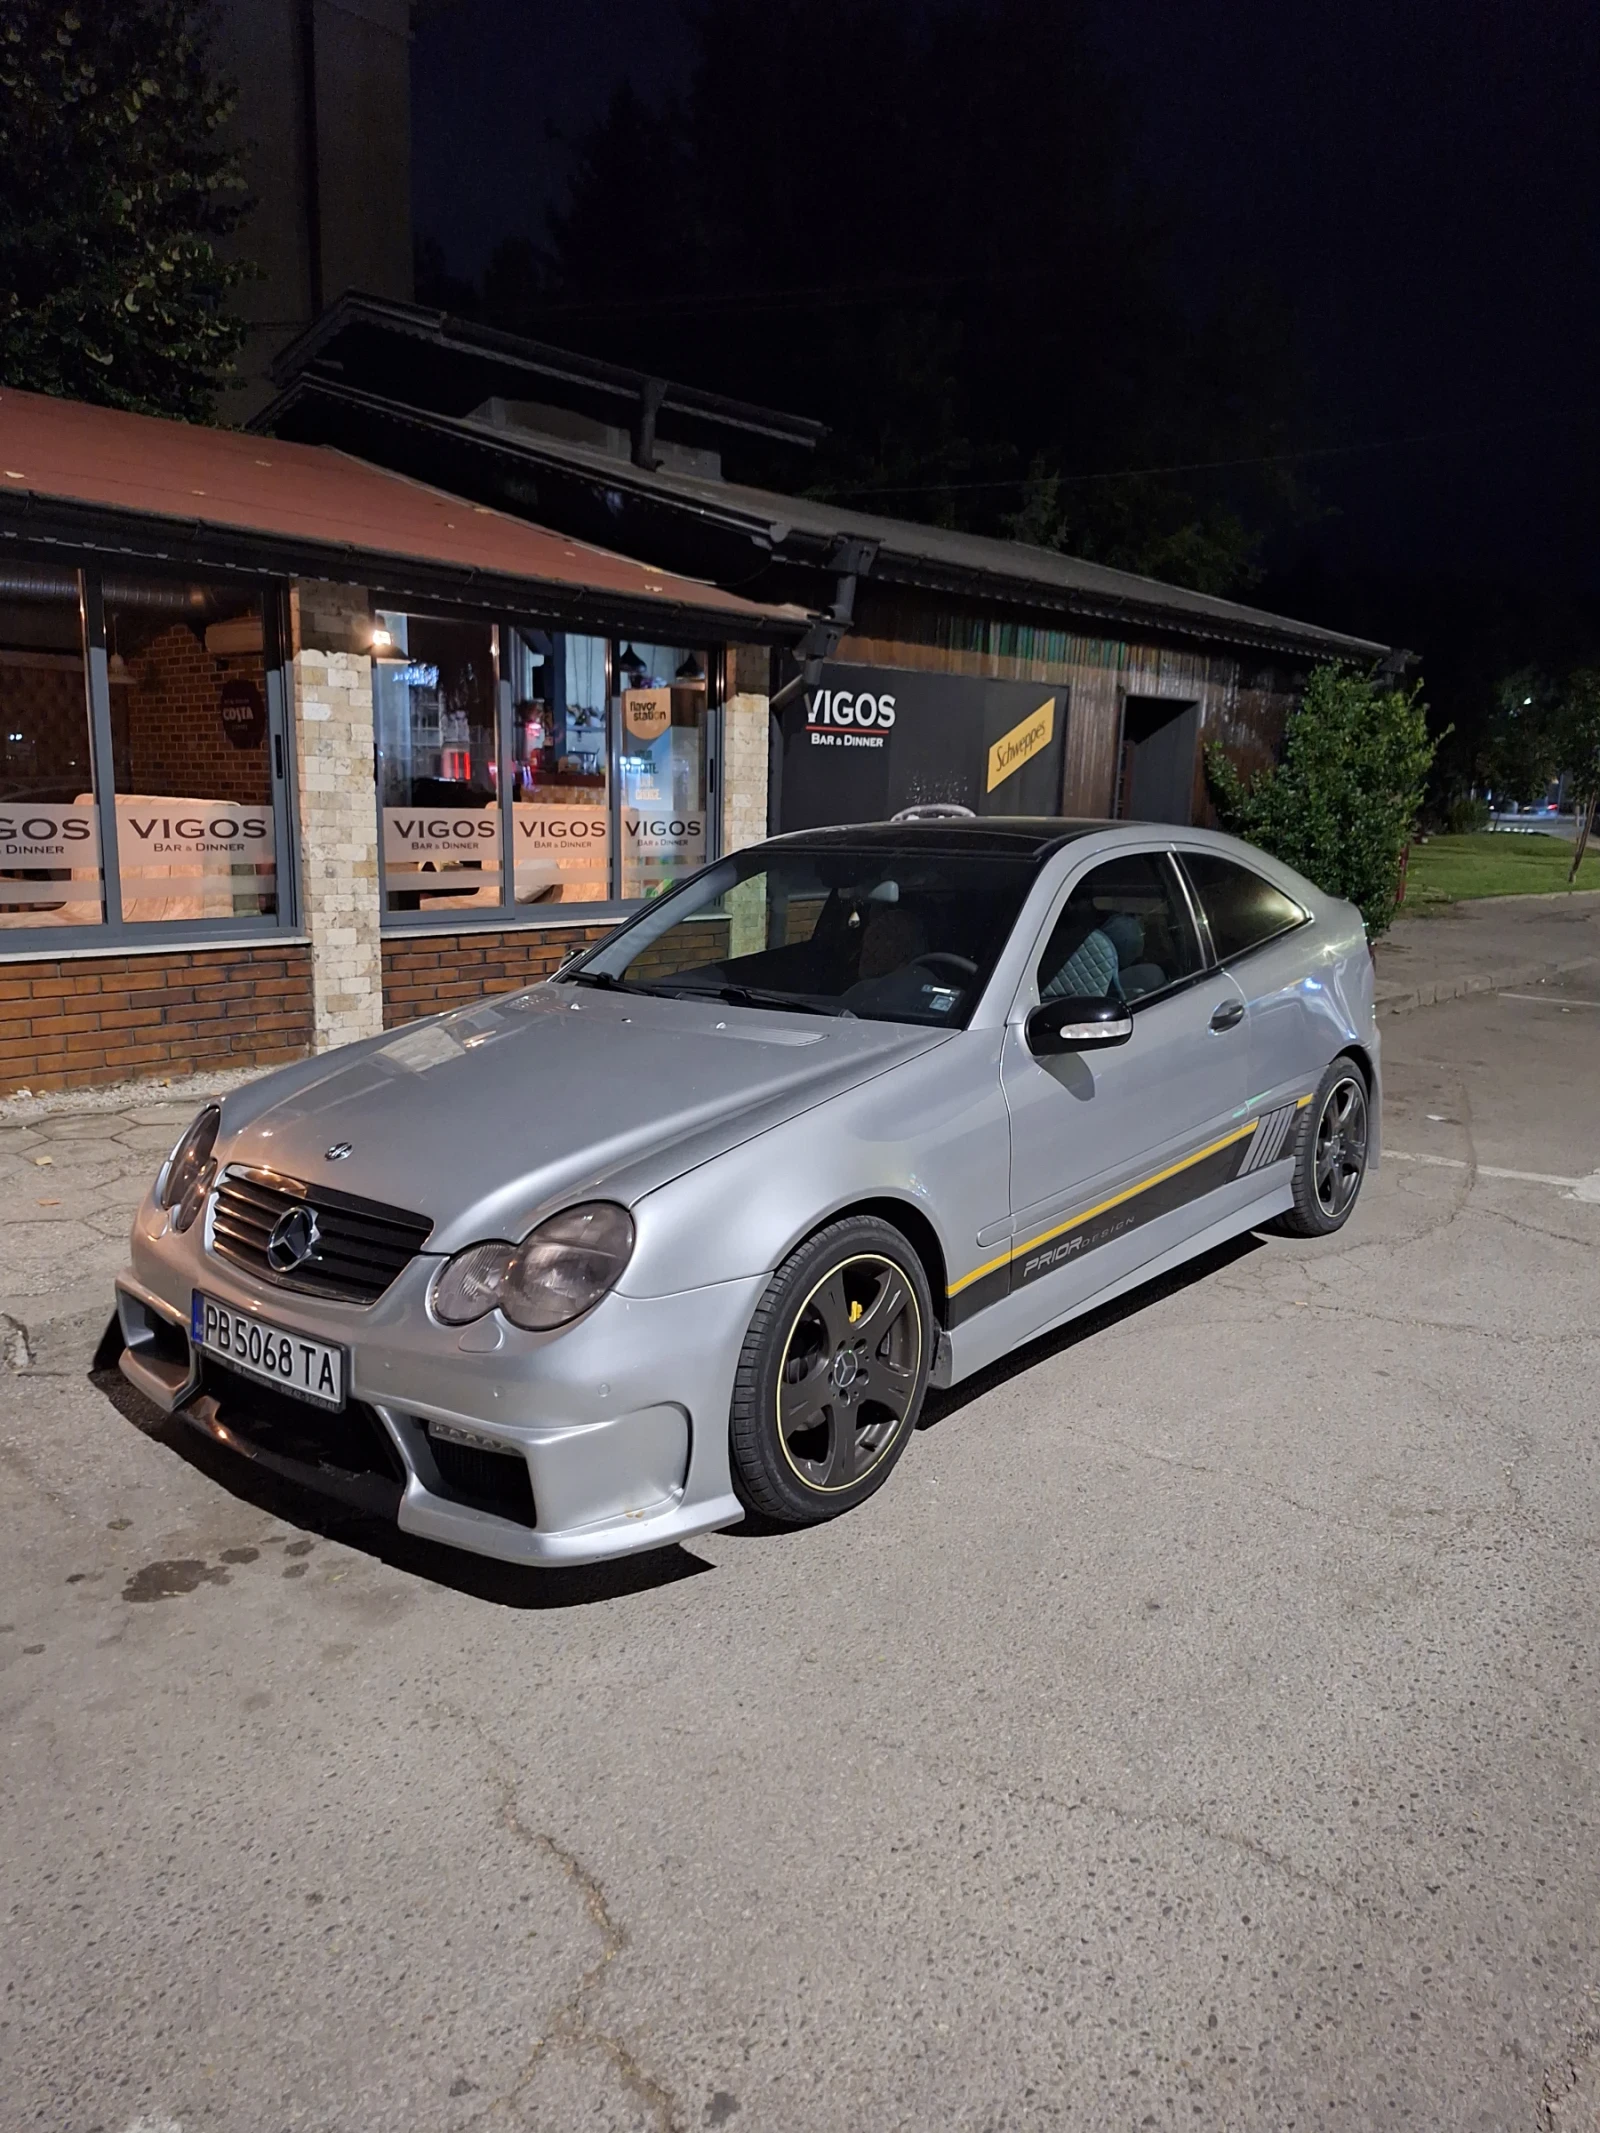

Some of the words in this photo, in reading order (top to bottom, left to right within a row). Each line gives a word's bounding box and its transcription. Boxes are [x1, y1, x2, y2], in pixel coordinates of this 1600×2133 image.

[223, 706, 254, 722] COSTA
[630, 701, 657, 712] flavor
[803, 689, 896, 728] VIGOS
[634, 710, 667, 721] station
[811, 732, 835, 745] BAR
[836, 737, 843, 746] &
[844, 734, 884, 747] DINNER
[996, 720, 1046, 772] Schweppes
[0, 818, 90, 840] GOS
[127, 818, 267, 839] VIGOS
[393, 820, 496, 838] VIGOS
[519, 820, 606, 838] VIGOS
[625, 820, 701, 837] VIGOS
[6, 844, 65, 855] DINNER
[153, 843, 182, 852] BAR
[195, 842, 246, 852] DINNER
[411, 842, 433, 850] BAR
[442, 841, 479, 850] DINNER
[534, 840, 552, 849] BAR
[560, 840, 592, 849] DINNER
[637, 839, 654, 847] BAR
[660, 838, 689, 847] DINNER
[1023, 1235, 1083, 1277] PRIOR
[1080, 1216, 1135, 1248] DESIGN
